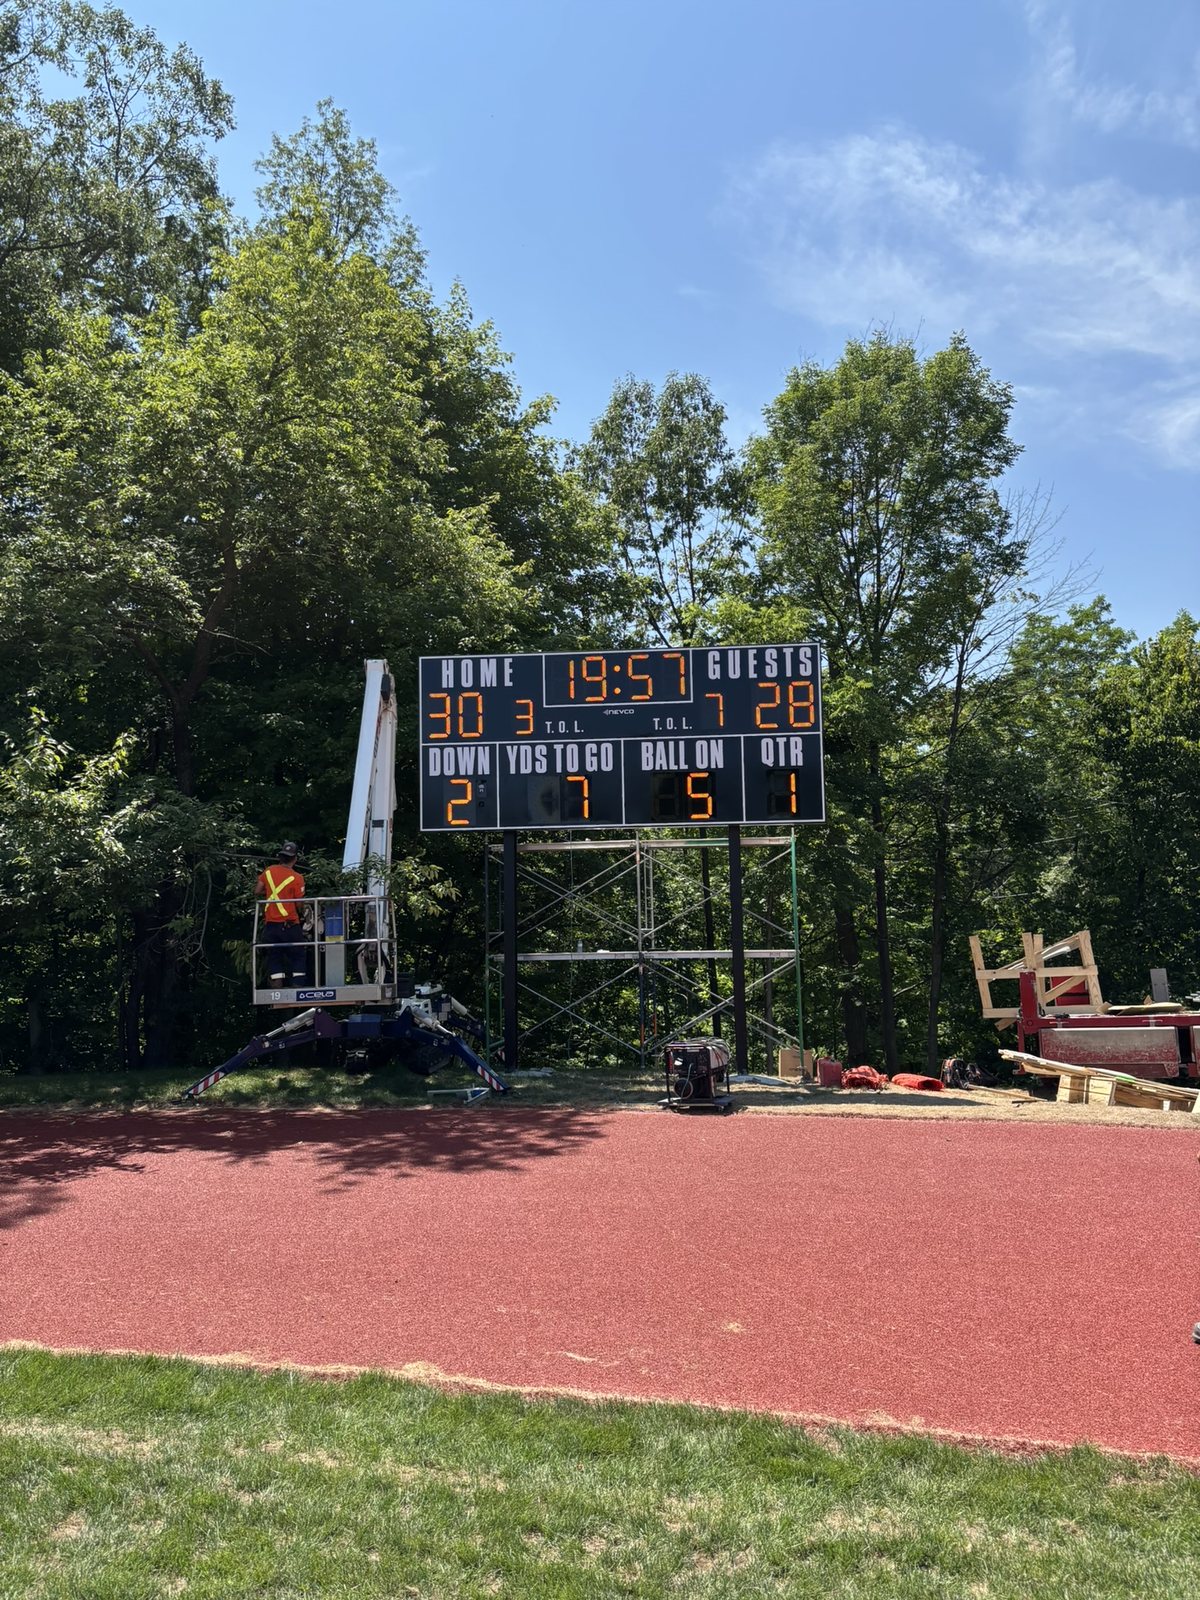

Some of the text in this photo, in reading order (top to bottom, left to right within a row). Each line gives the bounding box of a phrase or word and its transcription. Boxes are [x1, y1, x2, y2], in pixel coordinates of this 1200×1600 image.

[441, 658, 513, 689] HOME
[569, 653, 686, 702] 19:57
[708, 647, 812, 680] GUESTS
[429, 692, 483, 739] 30
[515, 699, 534, 735] 3
[705, 693, 724, 727] 7
[755, 681, 815, 729] 28
[429, 746, 490, 776] DOWN
[506, 742, 614, 774] YDS TO GO
[641, 739, 724, 771] BALL ON
[761, 737, 804, 767] QTR
[447, 778, 472, 825] 2
[566, 775, 589, 819] 7
[686, 772, 713, 820] 5
[790, 772, 797, 814] 1
[270, 991, 281, 1000] 19
